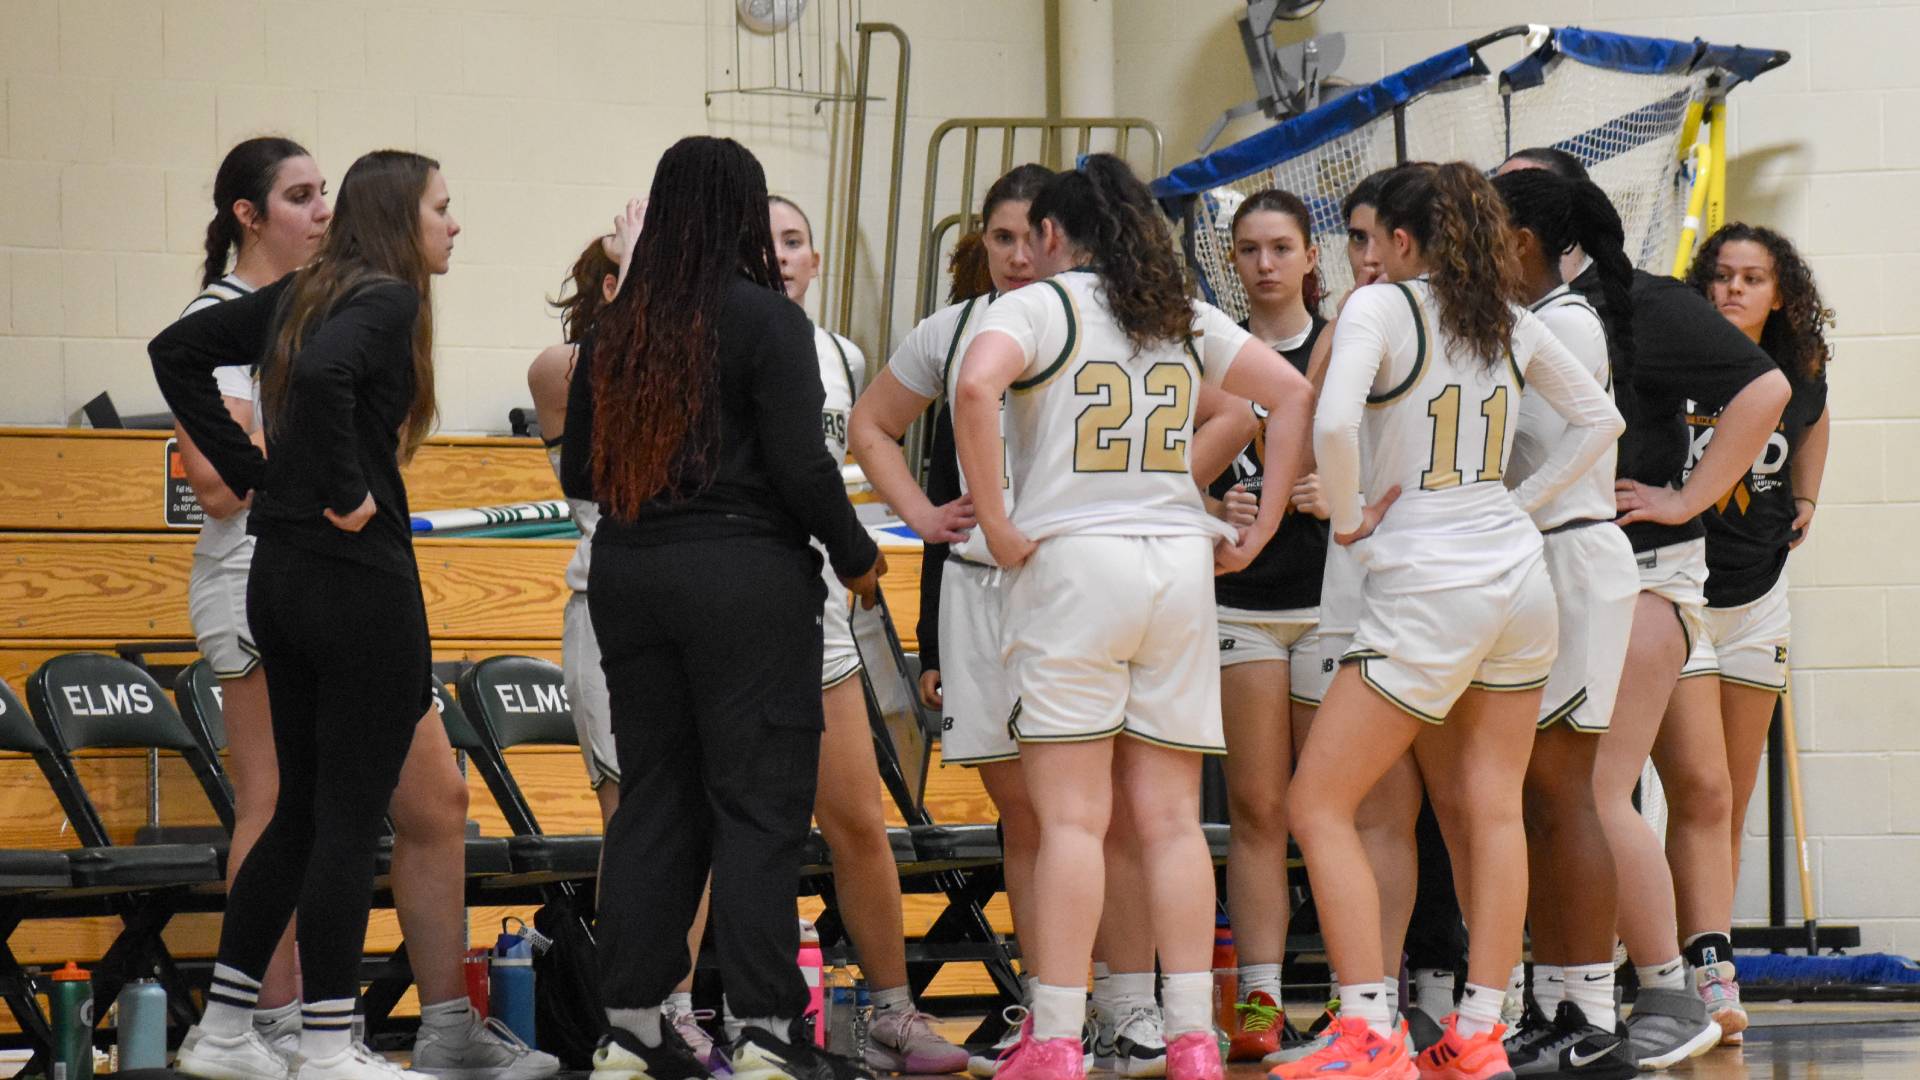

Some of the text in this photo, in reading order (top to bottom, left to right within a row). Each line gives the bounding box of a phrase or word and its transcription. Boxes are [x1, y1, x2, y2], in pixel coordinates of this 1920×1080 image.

[1072, 360, 1192, 474] 22
[1419, 384, 1508, 490] 11
[1684, 425, 1789, 474] KD
[173, 504, 180, 512] Do
[181, 504, 191, 512] NOT
[62, 683, 154, 717] ELMS
